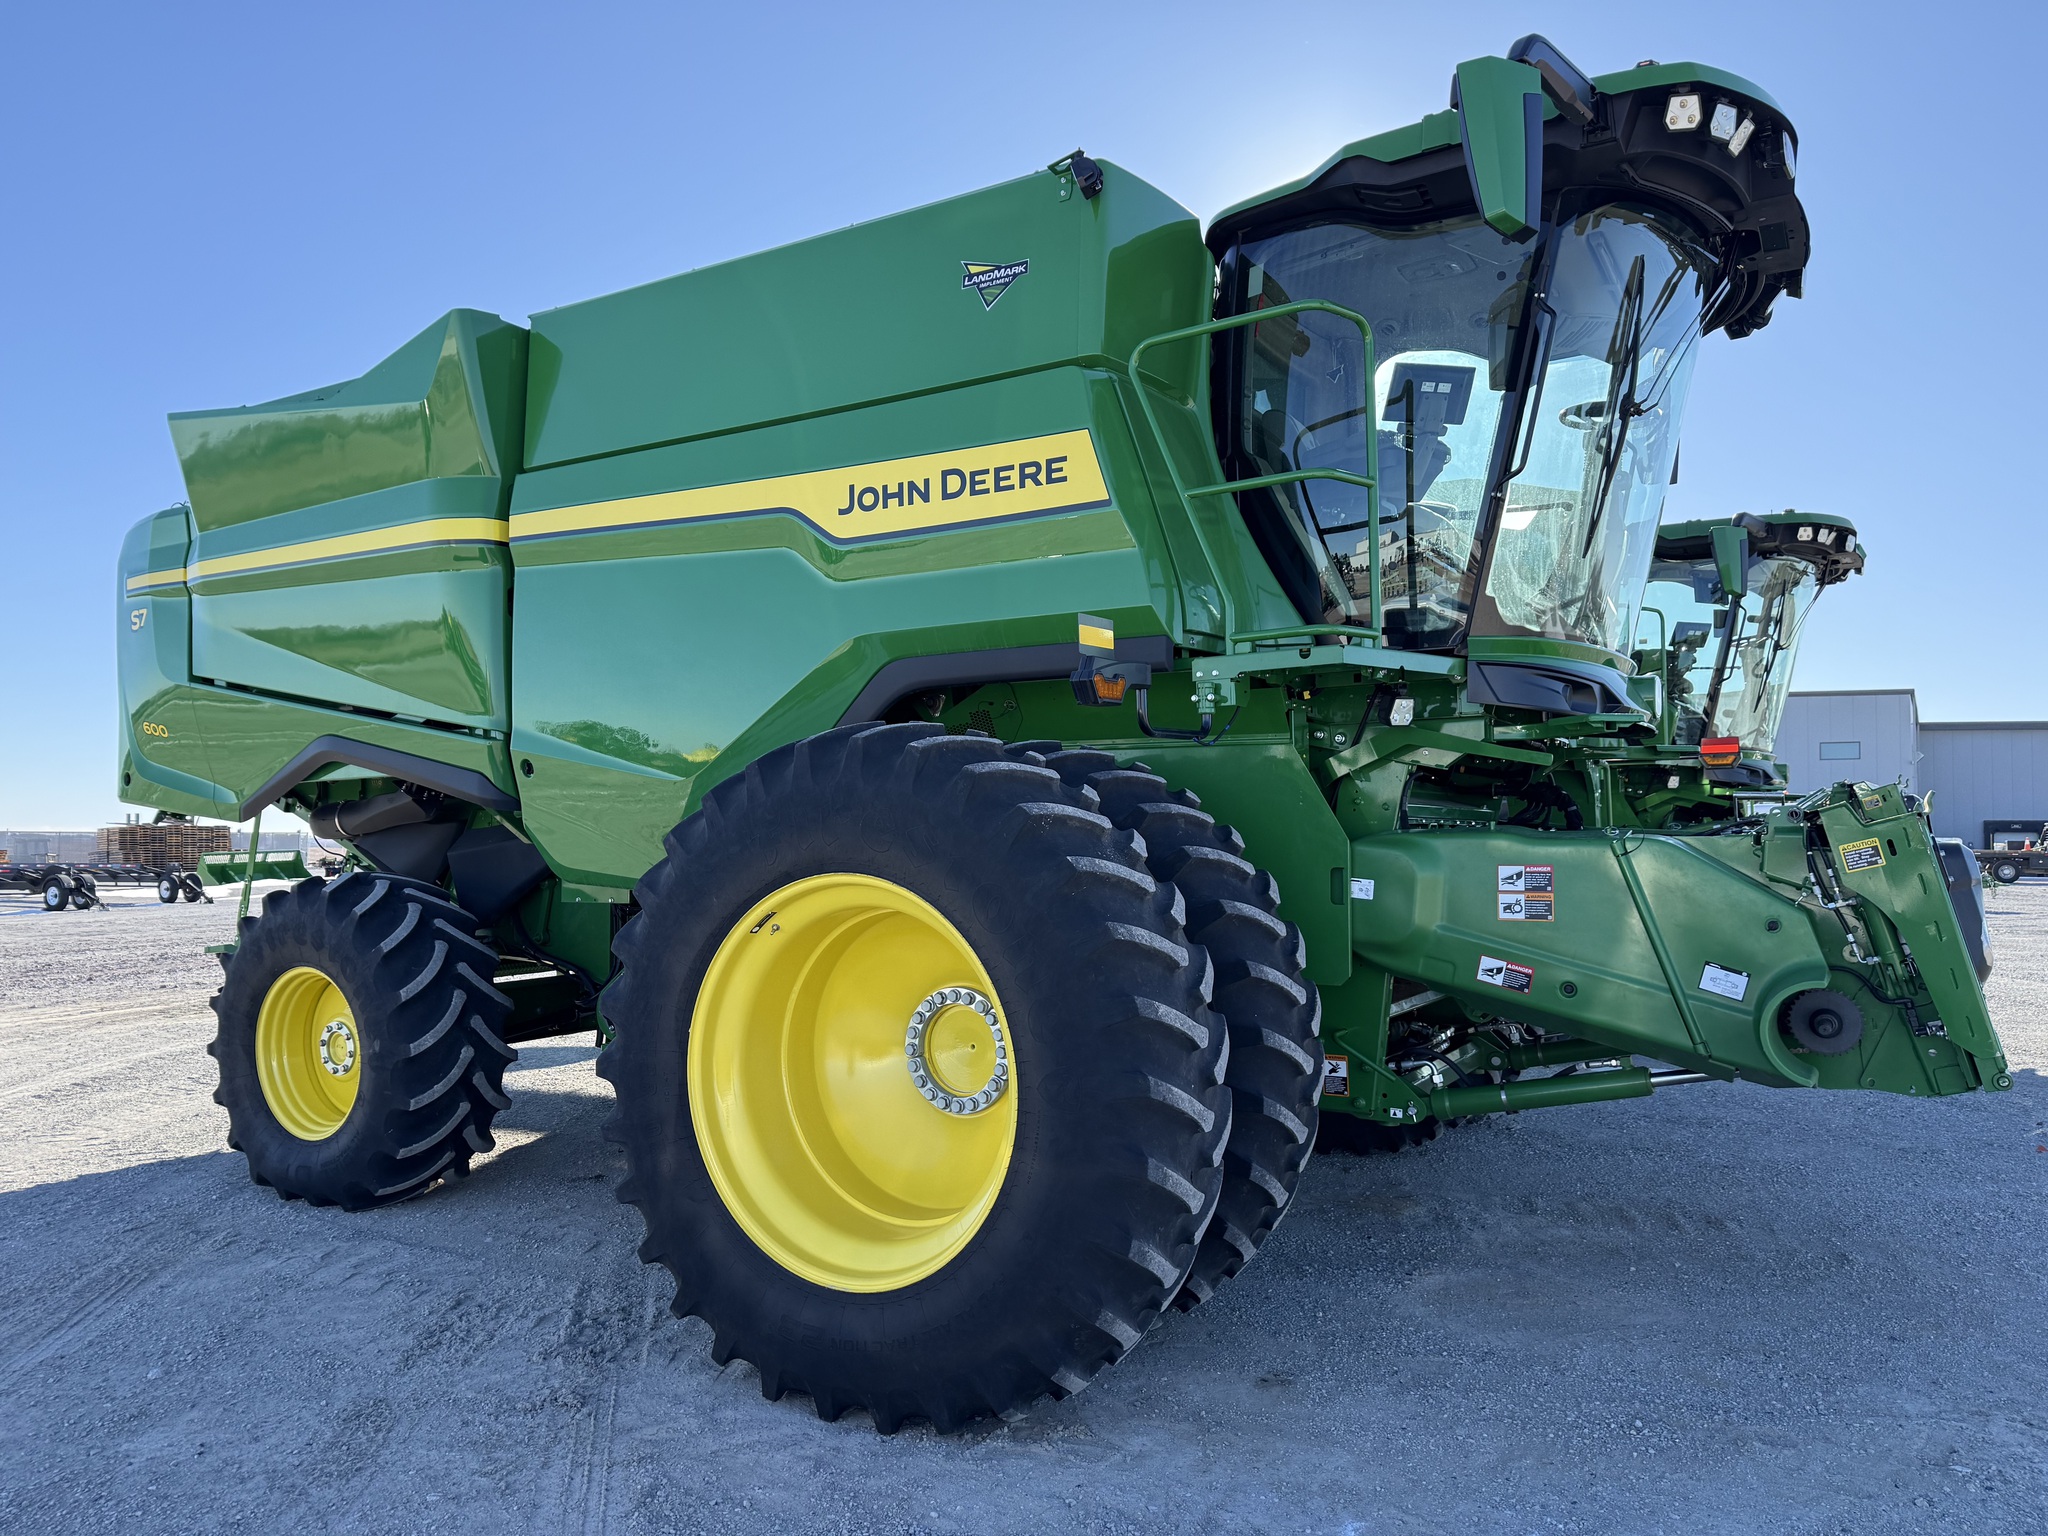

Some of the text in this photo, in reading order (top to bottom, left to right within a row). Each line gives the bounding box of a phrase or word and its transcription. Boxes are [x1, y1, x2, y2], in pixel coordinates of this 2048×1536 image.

[964, 264, 1027, 286] LANDMARK
[979, 276, 1013, 289] IMPLEMENT
[838, 455, 1068, 516] JOHN DEERE
[130, 608, 148, 631] S7
[142, 721, 169, 738] 600
[1846, 839, 1877, 850] CAUTION
[1511, 963, 1533, 974] DANGER
